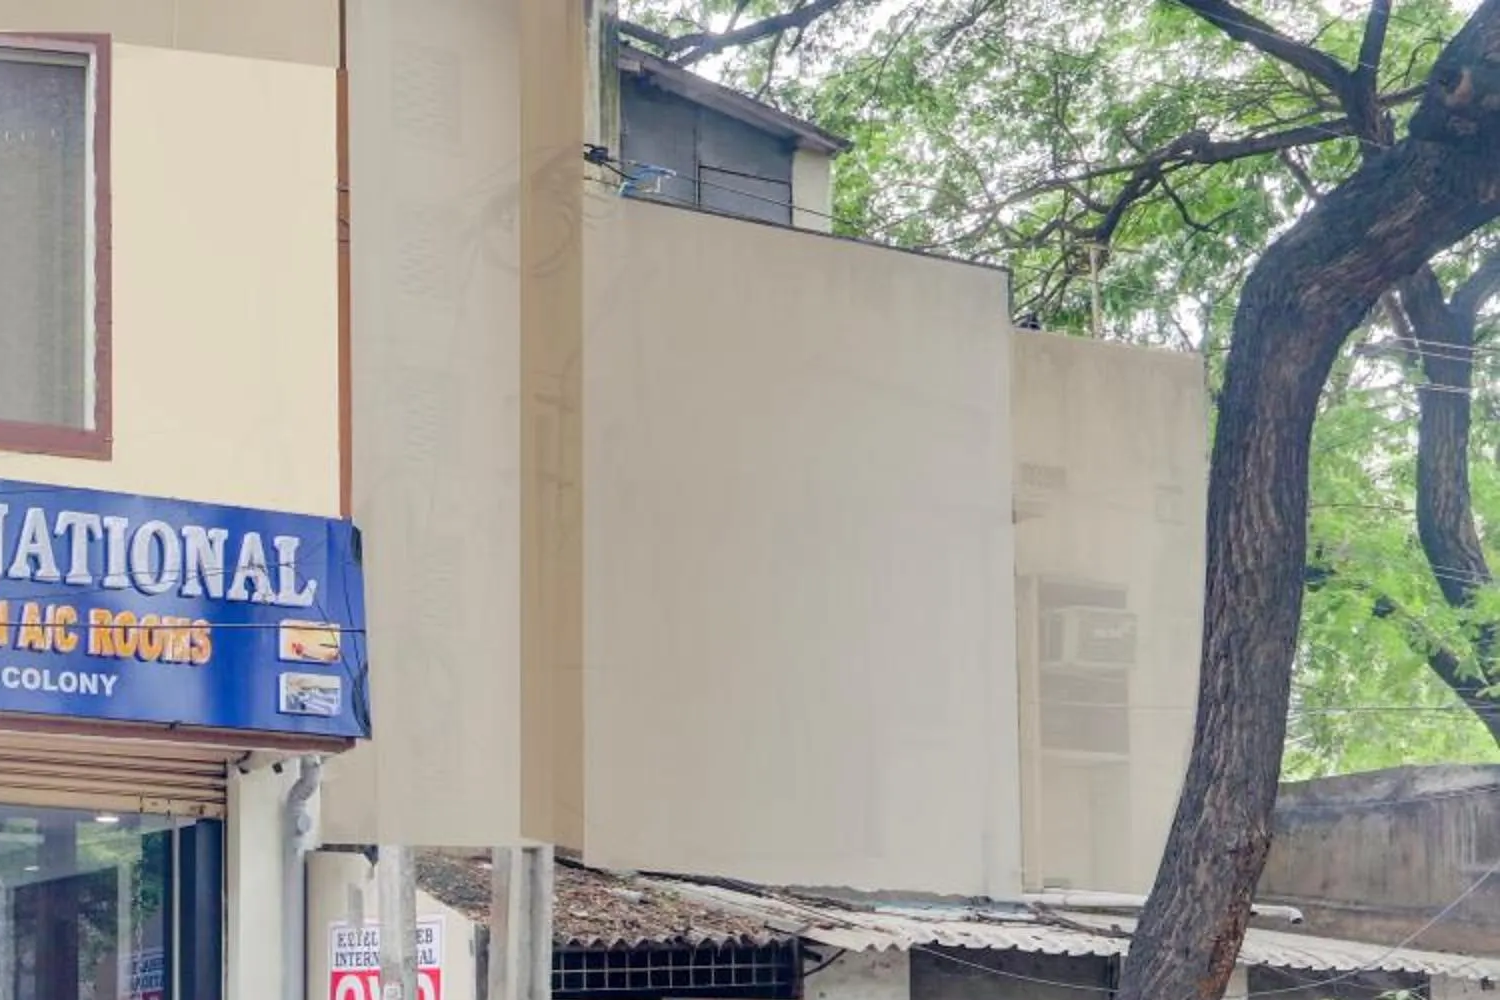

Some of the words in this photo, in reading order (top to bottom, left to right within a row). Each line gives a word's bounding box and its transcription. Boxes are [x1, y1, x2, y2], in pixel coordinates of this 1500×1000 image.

[17, 601, 79, 654] A/C
[87, 606, 212, 665] ROOMS
[1, 665, 119, 697] COLONY
